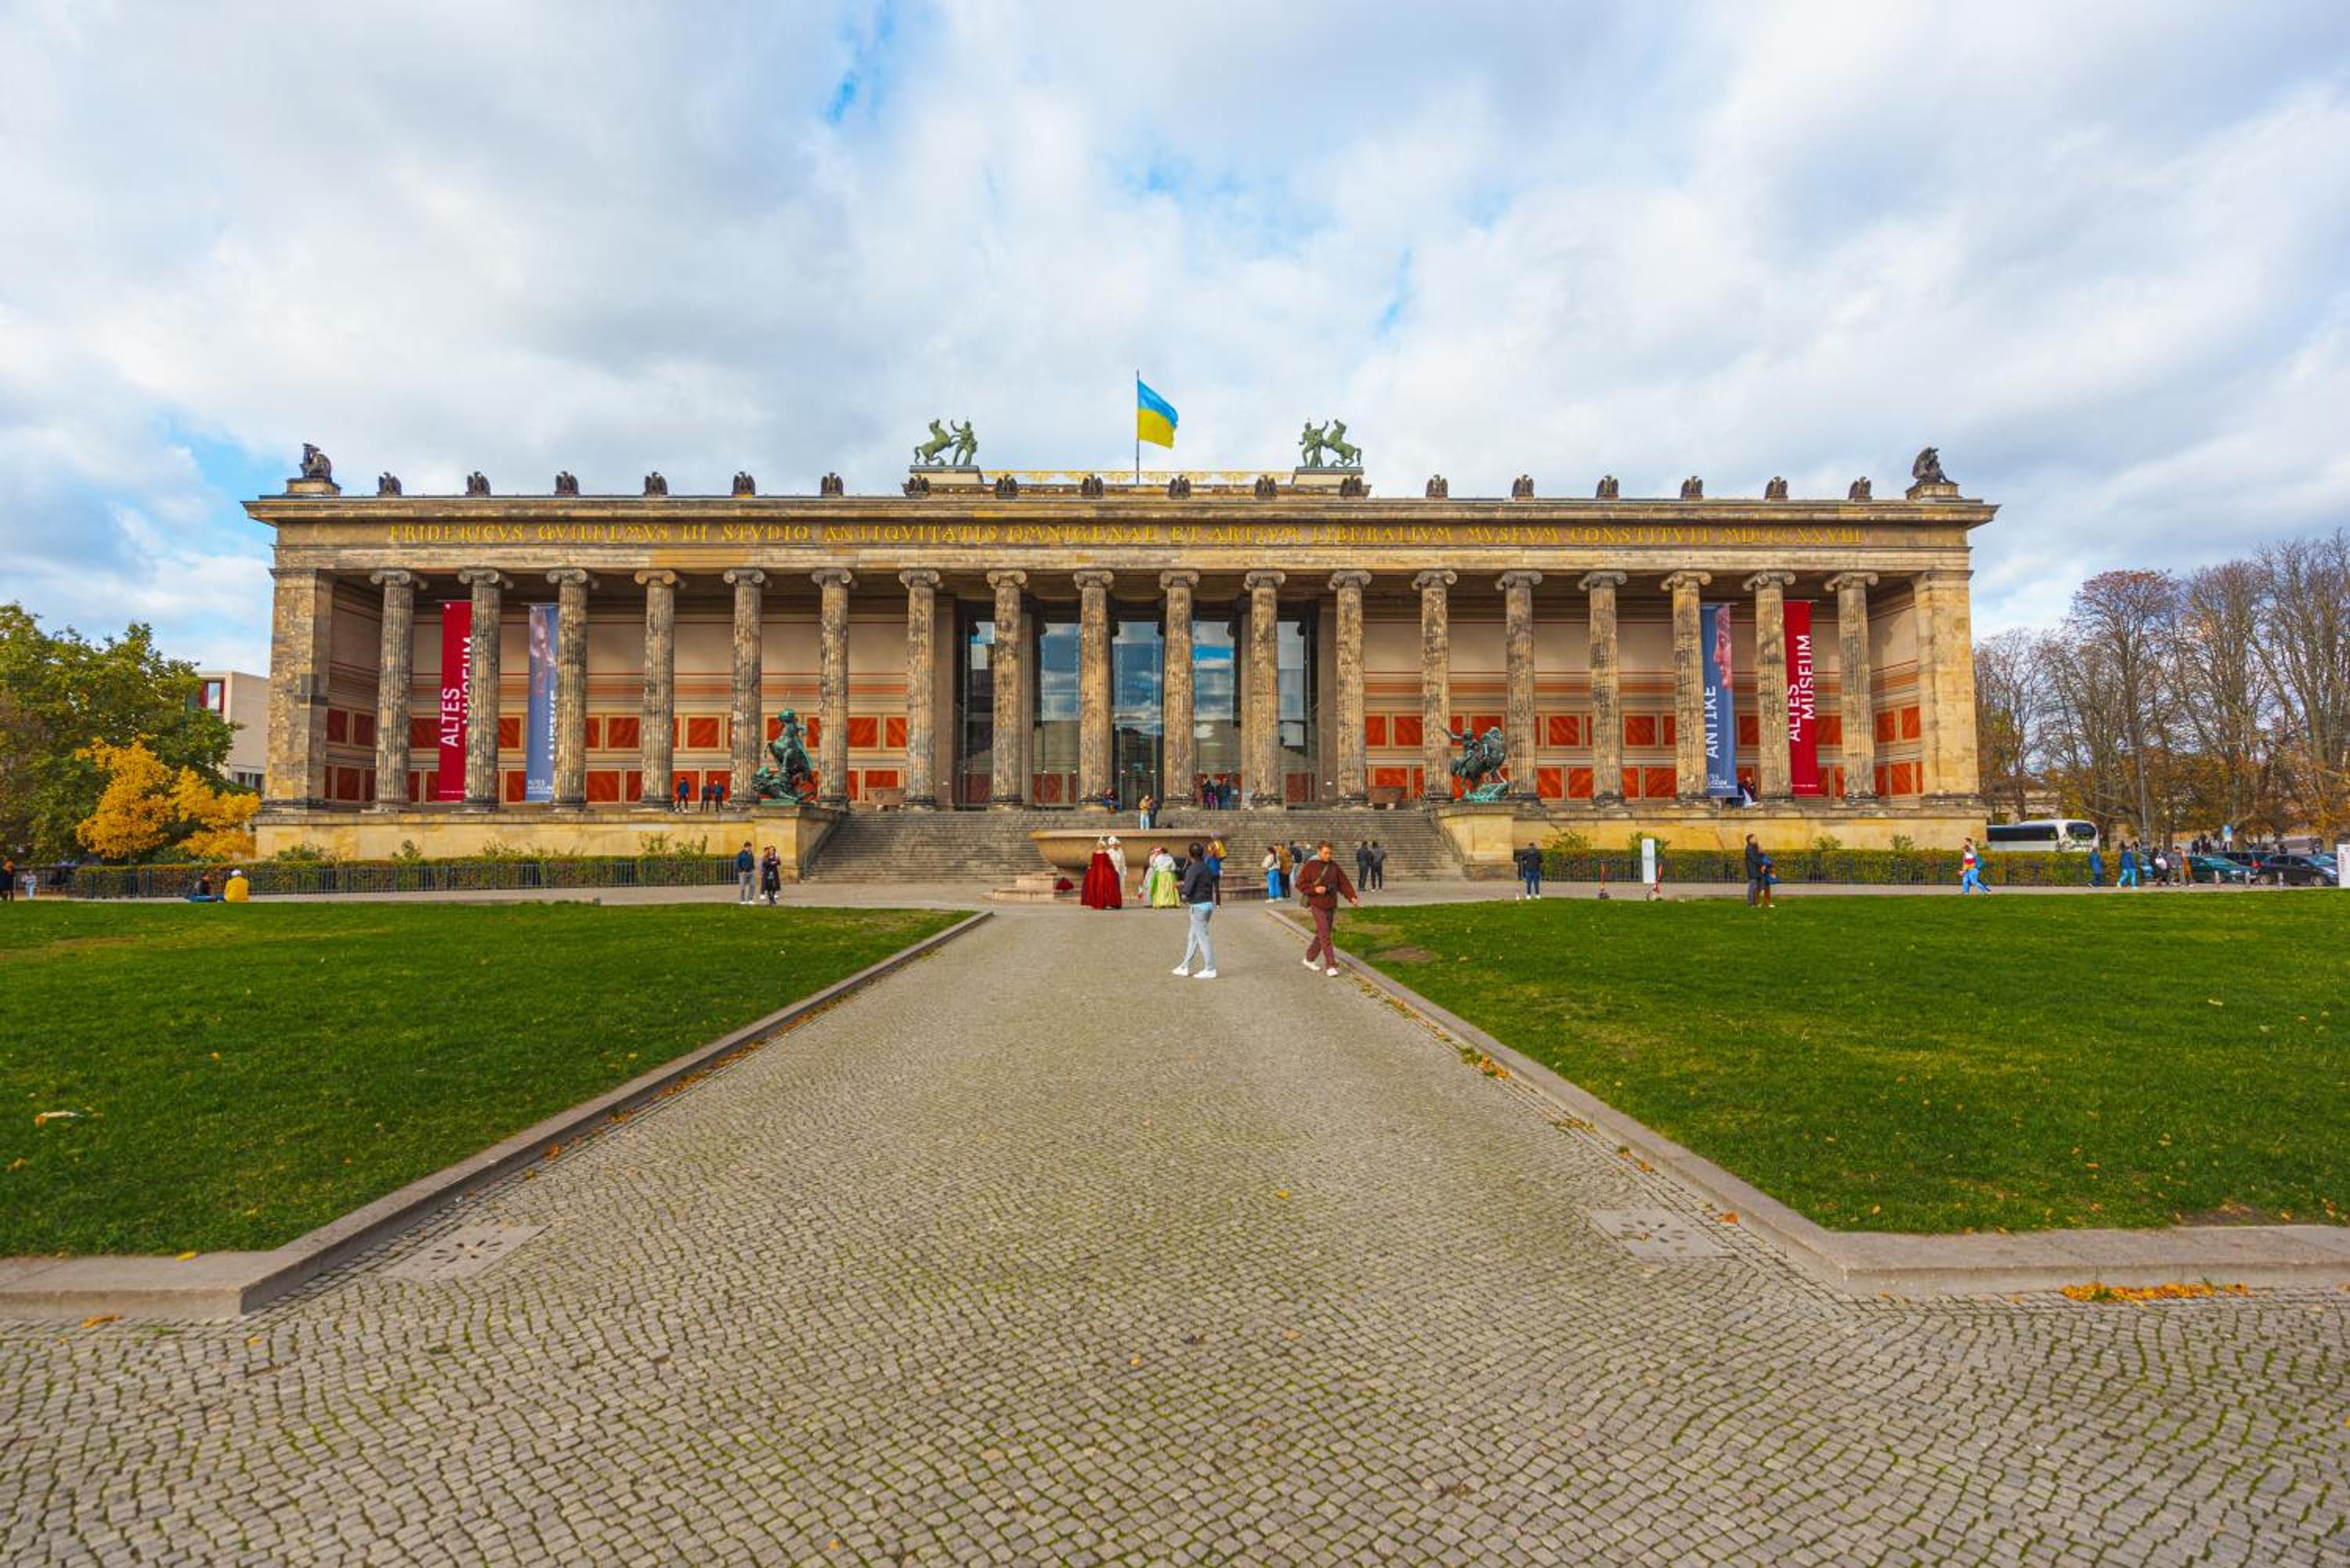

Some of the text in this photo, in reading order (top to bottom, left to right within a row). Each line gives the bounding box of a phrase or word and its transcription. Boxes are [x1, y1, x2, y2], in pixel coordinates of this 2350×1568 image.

[390, 526, 523, 540] FRIDERICVS
[682, 526, 707, 540] III
[721, 526, 809, 540] STVDIO
[824, 526, 998, 542] ANTIQVITATIS
[1170, 526, 1201, 542] ET
[1212, 526, 1302, 542] ARTIVM
[1466, 526, 1560, 544] MVSEVM
[1797, 634, 1816, 720] MUSEUM
[441, 688, 461, 747] ALTES
[1788, 684, 1802, 742] ALTES
